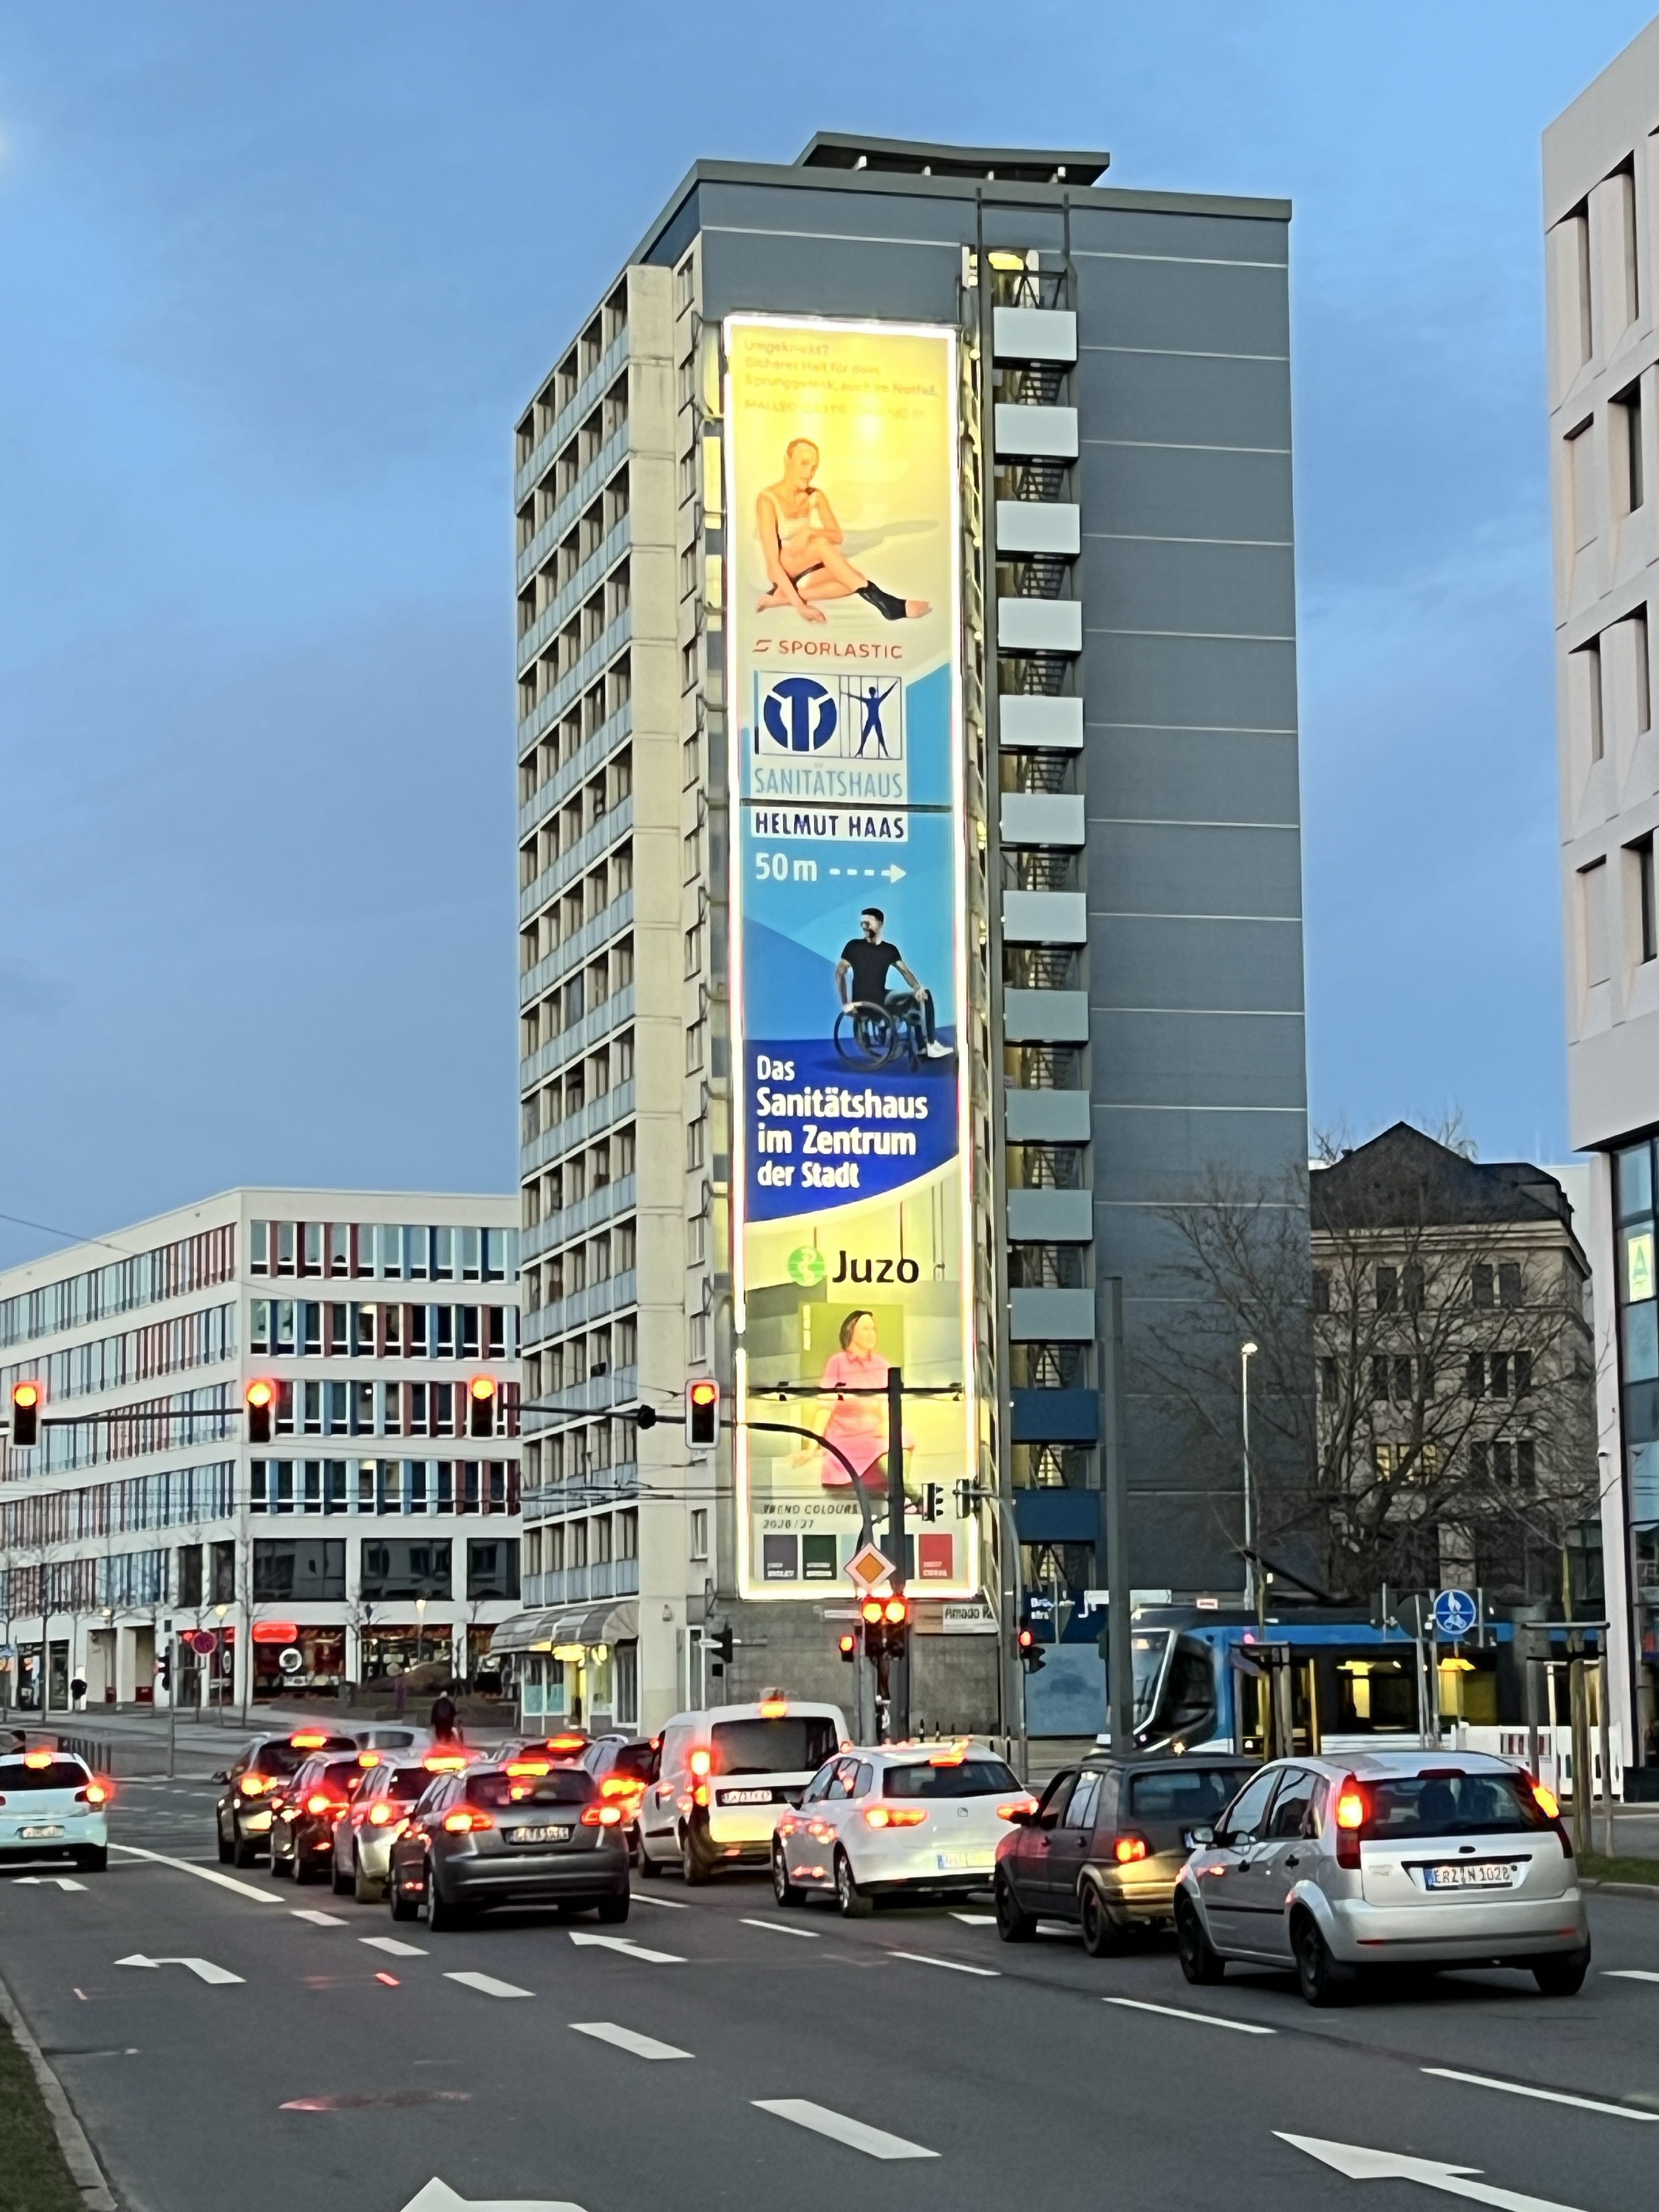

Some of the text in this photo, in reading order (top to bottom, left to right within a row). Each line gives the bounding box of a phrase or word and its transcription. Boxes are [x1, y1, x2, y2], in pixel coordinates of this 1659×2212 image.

[779, 640, 903, 659] SPORLASTIC
[754, 762, 903, 799] SANITÄTSHAUS
[755, 812, 904, 839] HELMUT HAAS
[757, 1055, 795, 1081] Das
[756, 1086, 929, 1120] Sanitätshaus
[757, 1123, 916, 1156] im Zentrum
[757, 1160, 860, 1188] der Stadt
[832, 1250, 919, 1284] Juzo
[804, 1504, 858, 1515] COLOURS
